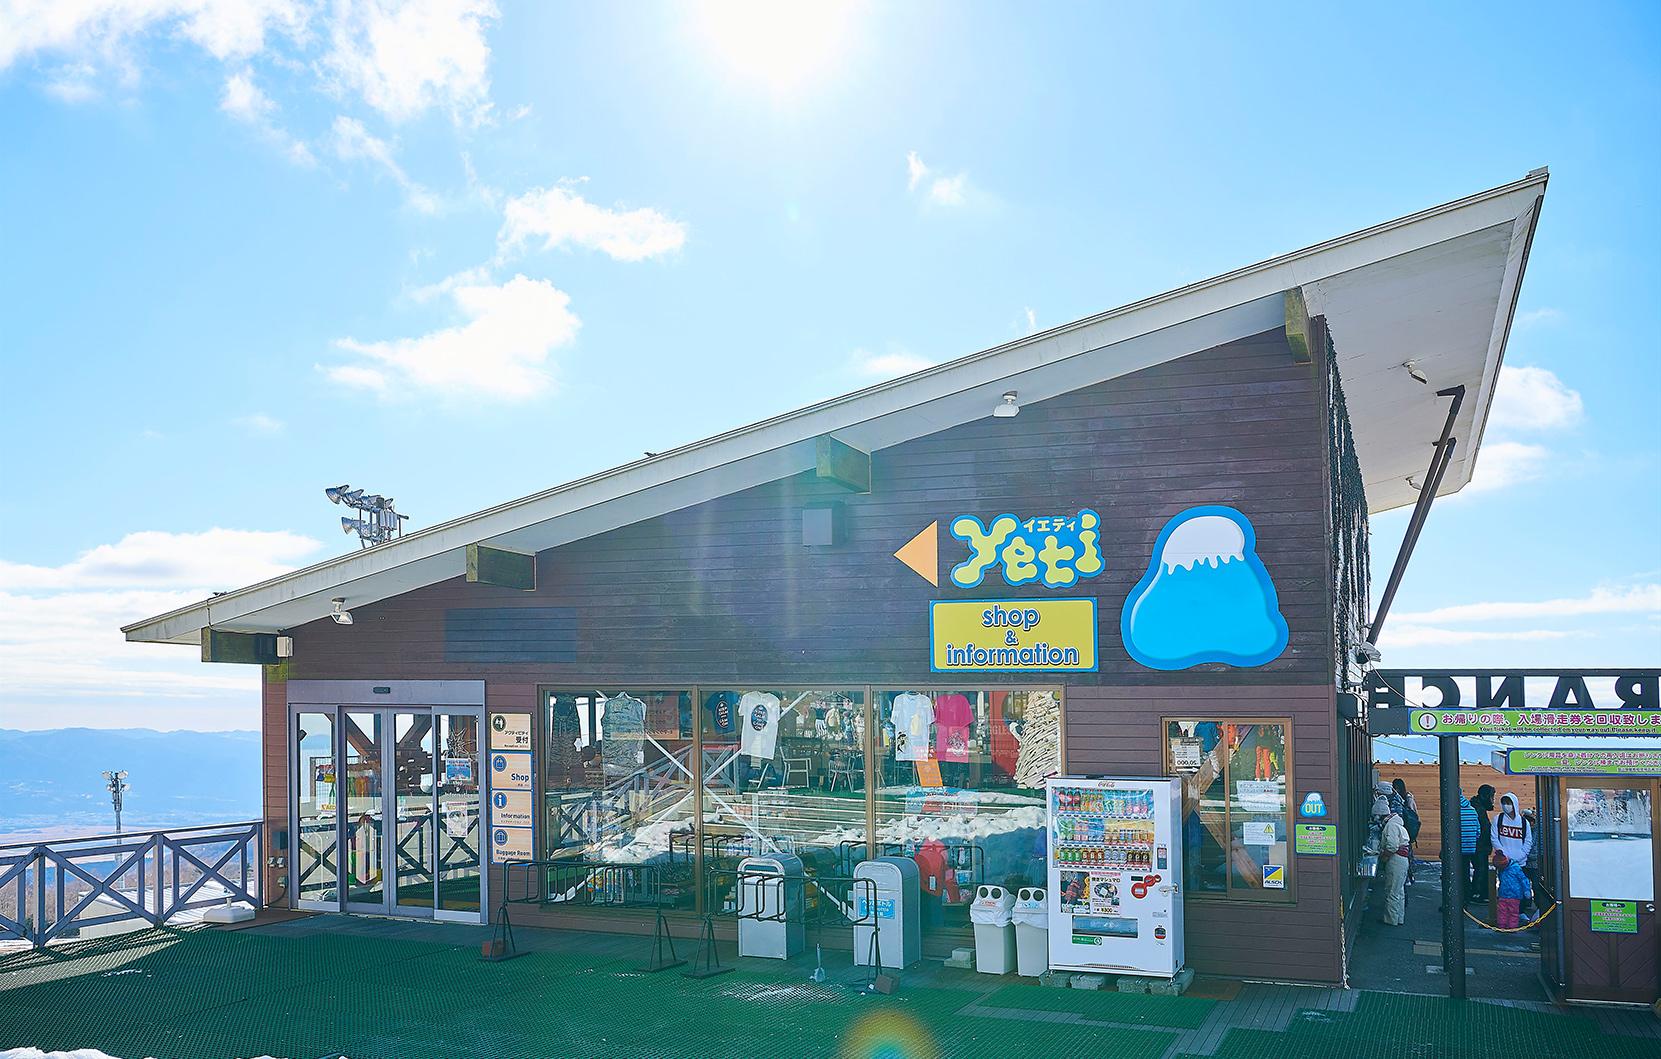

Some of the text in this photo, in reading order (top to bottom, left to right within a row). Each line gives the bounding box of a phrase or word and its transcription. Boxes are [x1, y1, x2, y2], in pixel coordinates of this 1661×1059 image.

[1023, 518, 1076, 533] イエティ
[981, 604, 1040, 631] shop
[1005, 629, 1018, 645] &
[946, 642, 1079, 666] information
[516, 736, 529, 744] 受付
[511, 773, 530, 782] Shop
[1305, 803, 1323, 814] OUT
[496, 849, 516, 857] Baggage
